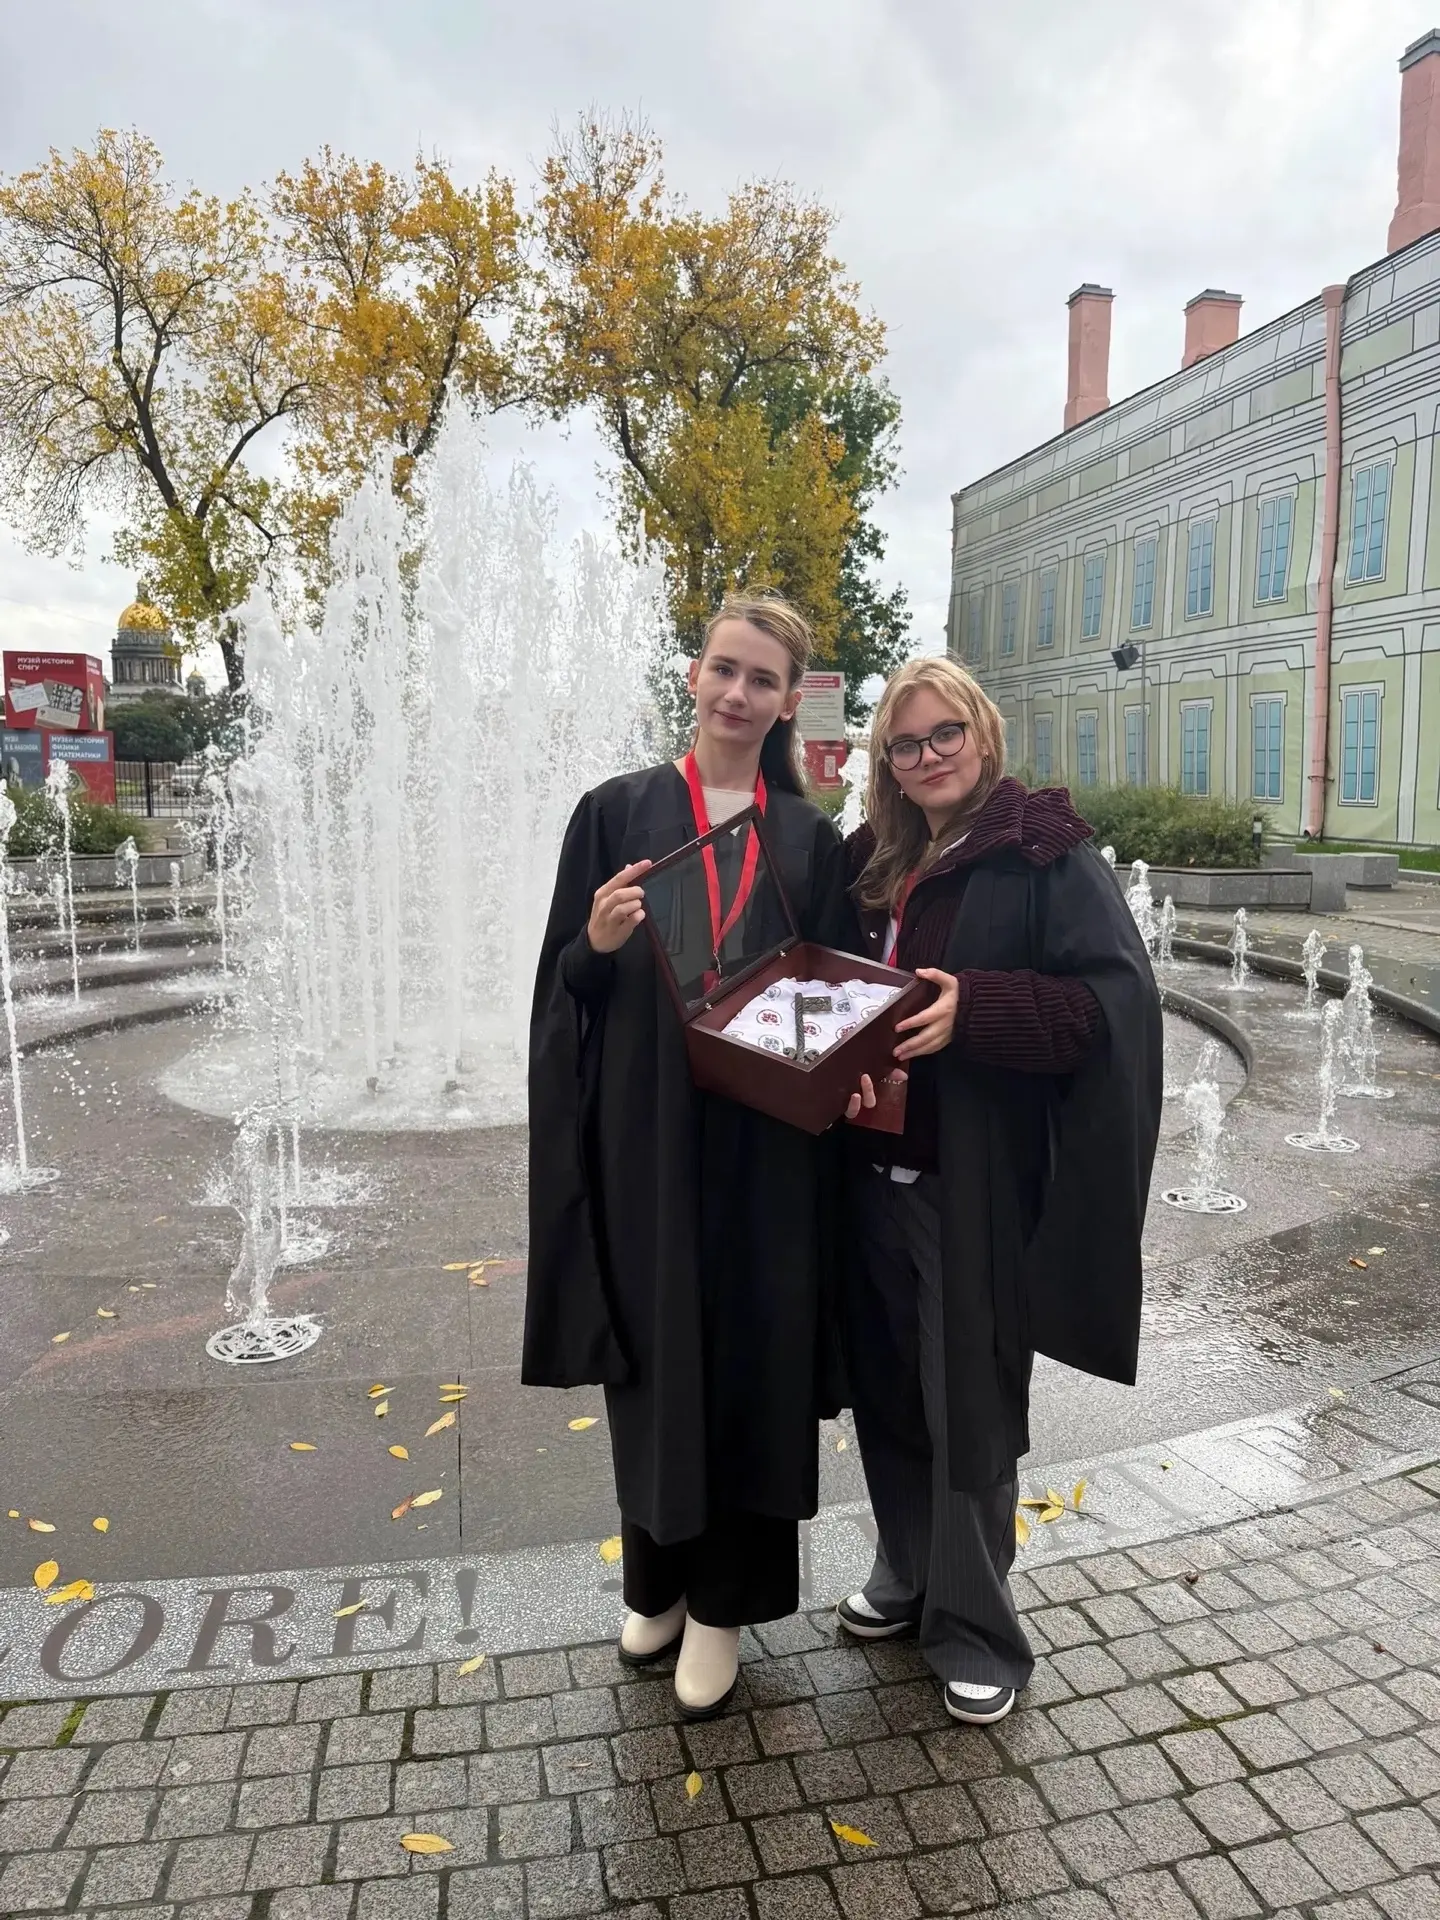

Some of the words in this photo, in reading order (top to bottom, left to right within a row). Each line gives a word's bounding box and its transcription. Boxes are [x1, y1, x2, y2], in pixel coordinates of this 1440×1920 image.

[51, 735, 73, 743] МУЗЕЙ
[51, 743, 80, 751] ФИЗИКИ
[58, 751, 102, 759] МАТЕМАТИКИ
[0, 1568, 482, 1683] ORE!
